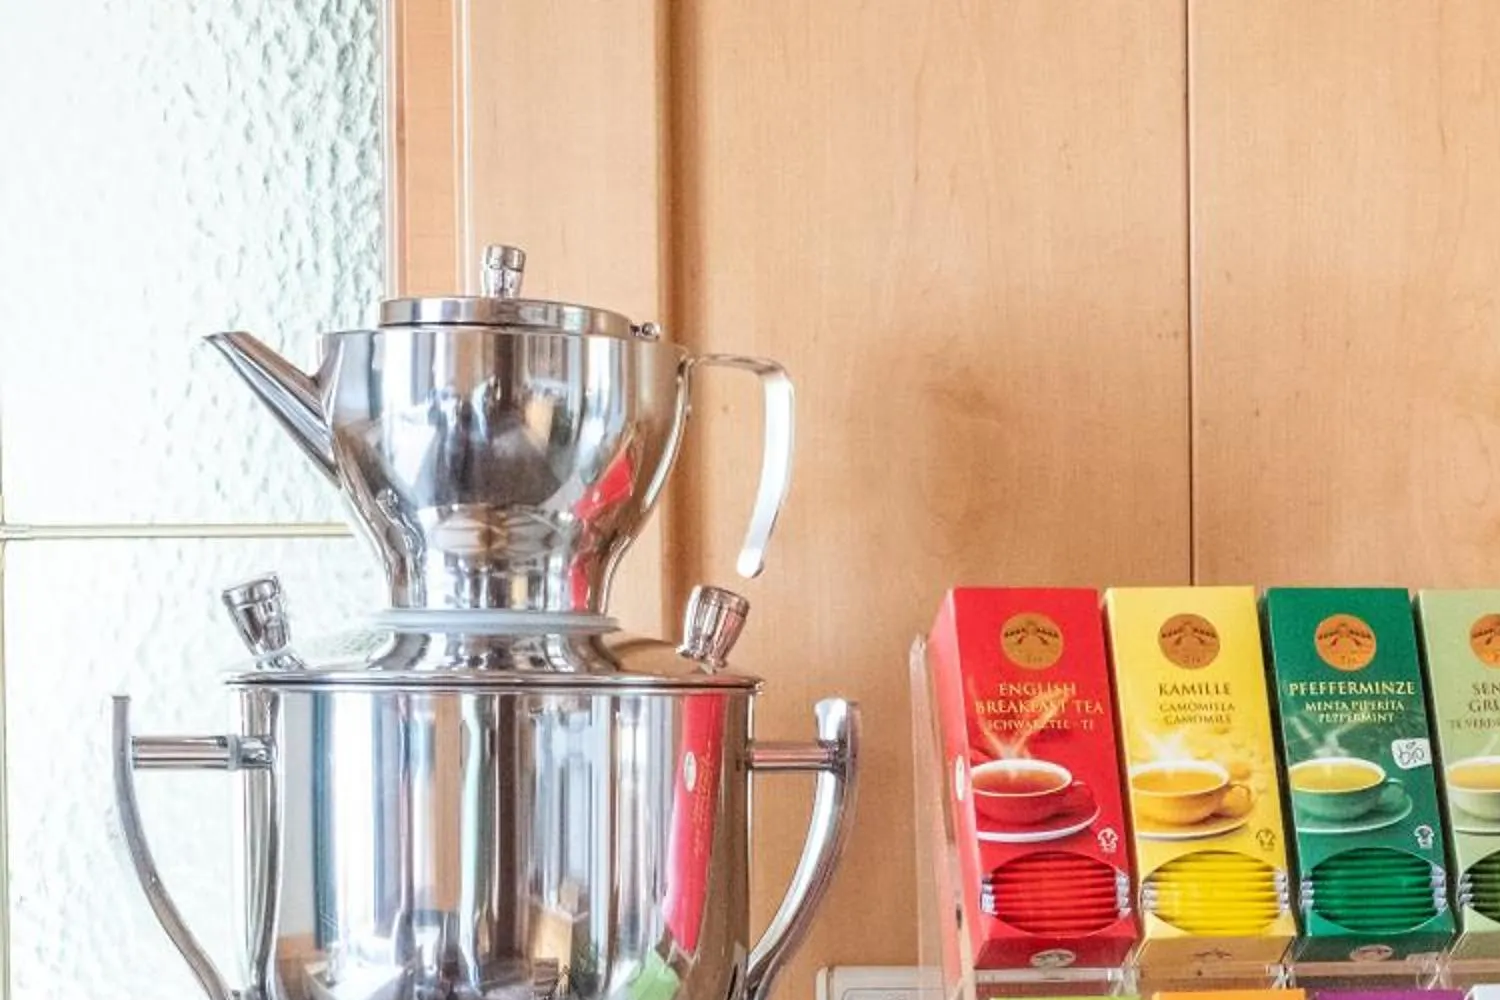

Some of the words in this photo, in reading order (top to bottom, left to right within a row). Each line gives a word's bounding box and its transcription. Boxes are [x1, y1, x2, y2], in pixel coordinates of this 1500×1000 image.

[999, 682, 1077, 697] ENGLISH
[1158, 682, 1232, 696] KAMILLE
[1289, 681, 1415, 696] PFEFFERMINZE
[975, 699, 1066, 714] BREAKFAST
[1072, 700, 1104, 714] TEA
